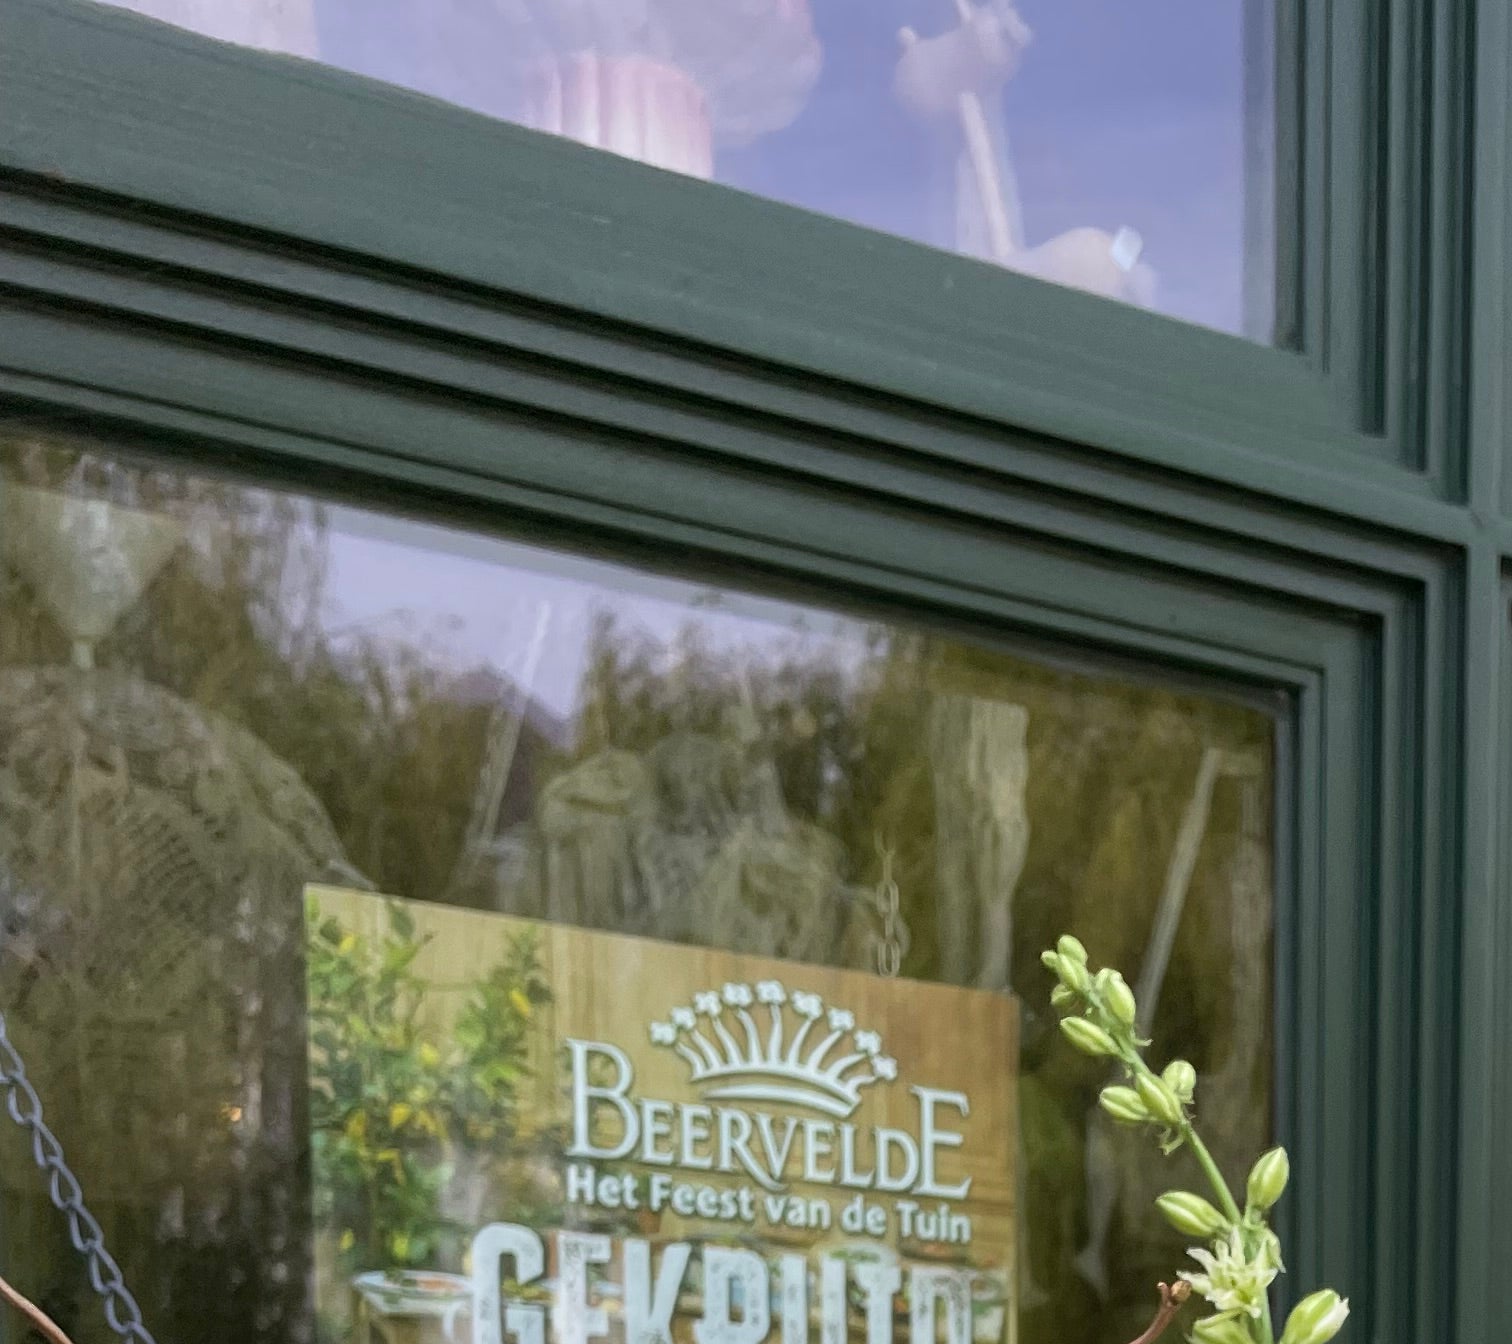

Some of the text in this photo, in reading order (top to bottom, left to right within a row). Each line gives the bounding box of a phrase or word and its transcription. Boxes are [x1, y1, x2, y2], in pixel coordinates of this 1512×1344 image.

[564, 1038, 973, 1200] BEERVELDE
[565, 1163, 972, 1244] Het Feest van de Tuin
